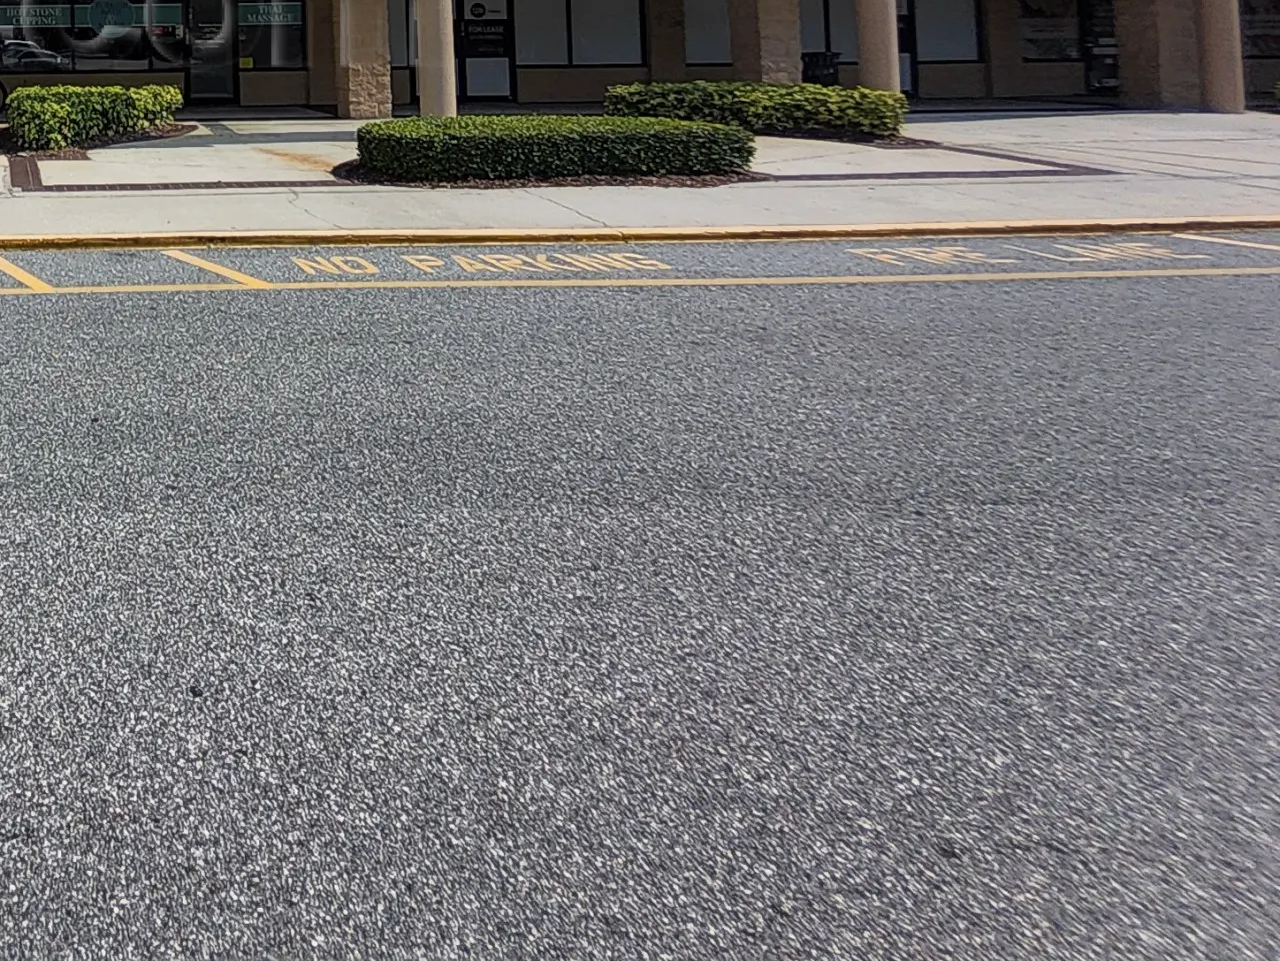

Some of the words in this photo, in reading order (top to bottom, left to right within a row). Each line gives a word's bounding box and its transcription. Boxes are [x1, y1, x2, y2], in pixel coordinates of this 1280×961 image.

[29, 8, 62, 16] STONE
[258, 6, 283, 14] THAI
[12, 17, 56, 25] CUPPING
[247, 14, 292, 22] MASSAGE
[291, 254, 380, 275] NO
[401, 252, 673, 273] PARKING
